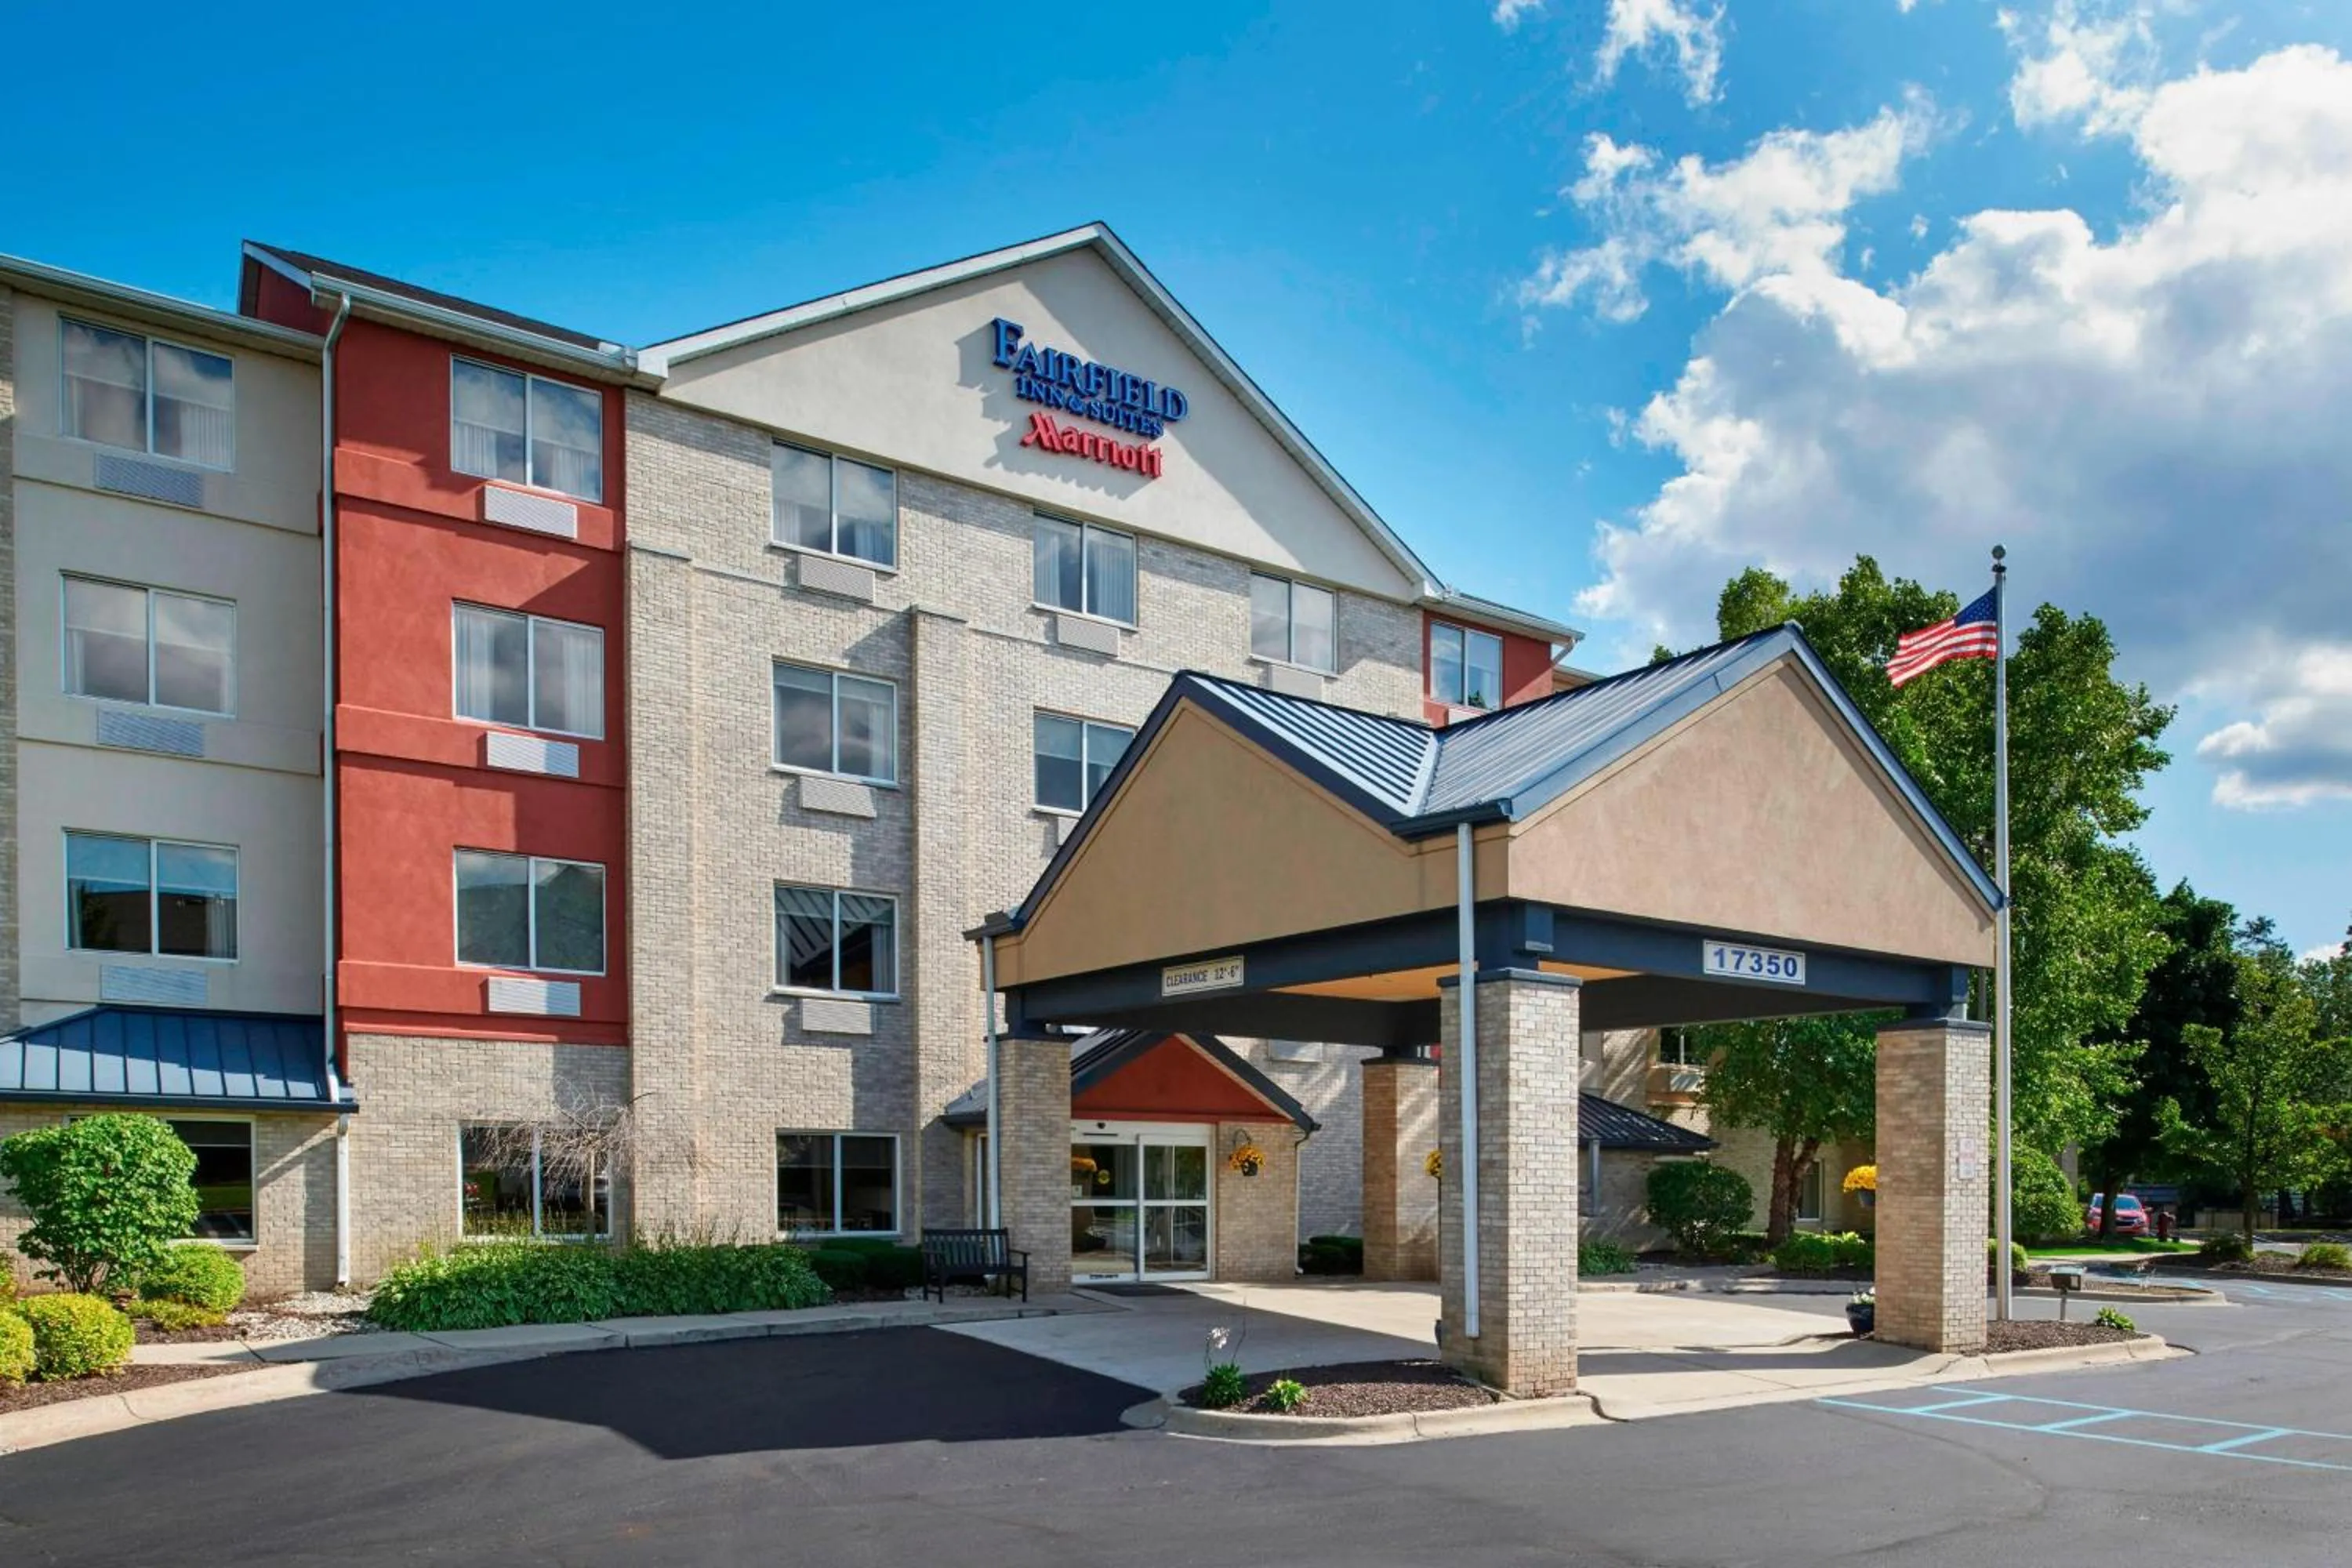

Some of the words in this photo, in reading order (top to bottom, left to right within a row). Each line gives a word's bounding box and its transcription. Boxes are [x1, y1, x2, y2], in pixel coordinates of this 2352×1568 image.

[992, 317, 1188, 422] FAIRFIELD
[1016, 376, 1065, 409] INN
[1065, 394, 1086, 416] &
[1086, 401, 1164, 440] SUITES
[1020, 412, 1163, 479] Marriott
[1166, 969, 1208, 987] CLEARANCE
[1714, 947, 1798, 977] 17350
